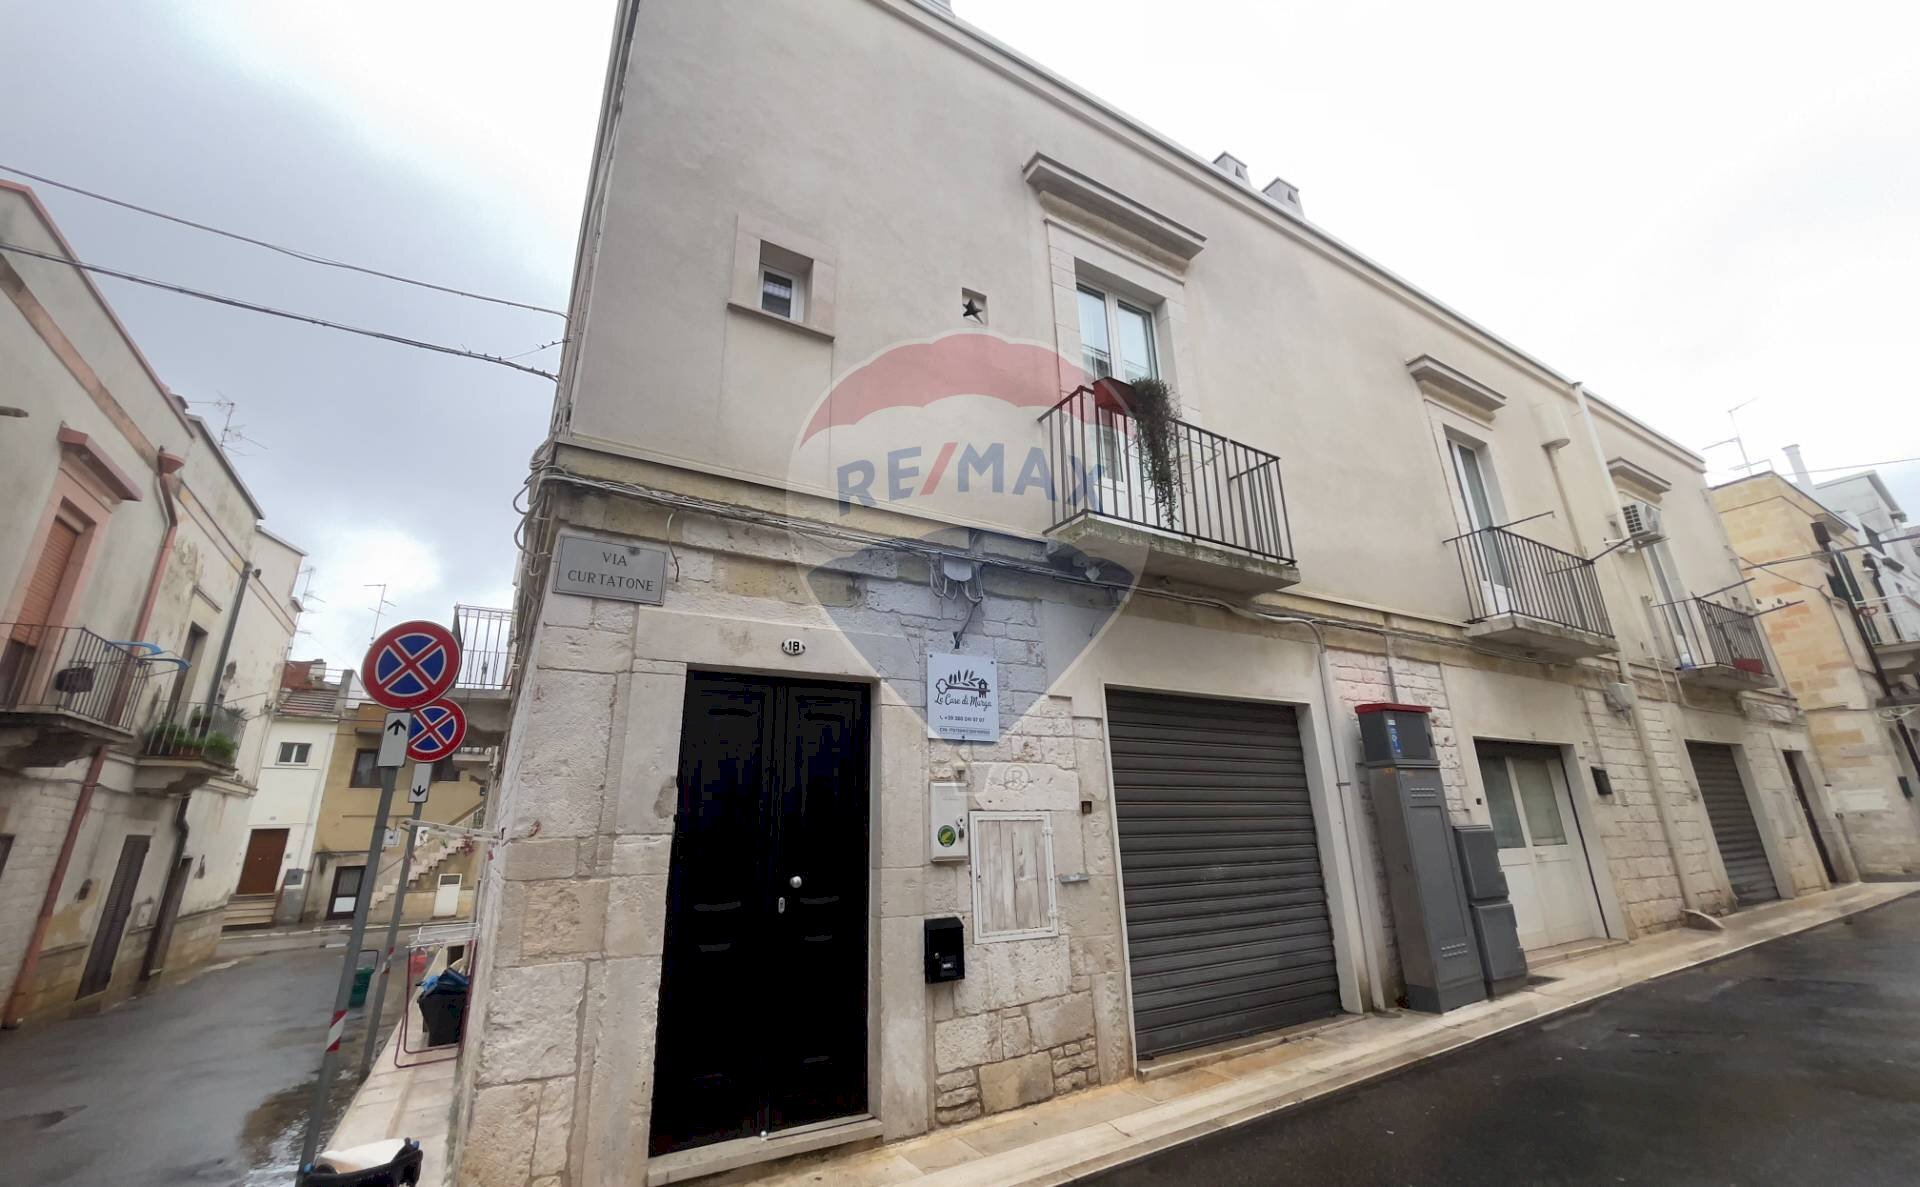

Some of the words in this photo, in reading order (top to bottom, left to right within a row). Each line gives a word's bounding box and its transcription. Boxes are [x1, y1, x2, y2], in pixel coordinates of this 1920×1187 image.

[602, 551, 627, 567] VIA
[567, 569, 654, 592] CURTATONE
[934, 692, 944, 705] Le
[945, 693, 961, 706] Case
[962, 694, 969, 705] di
